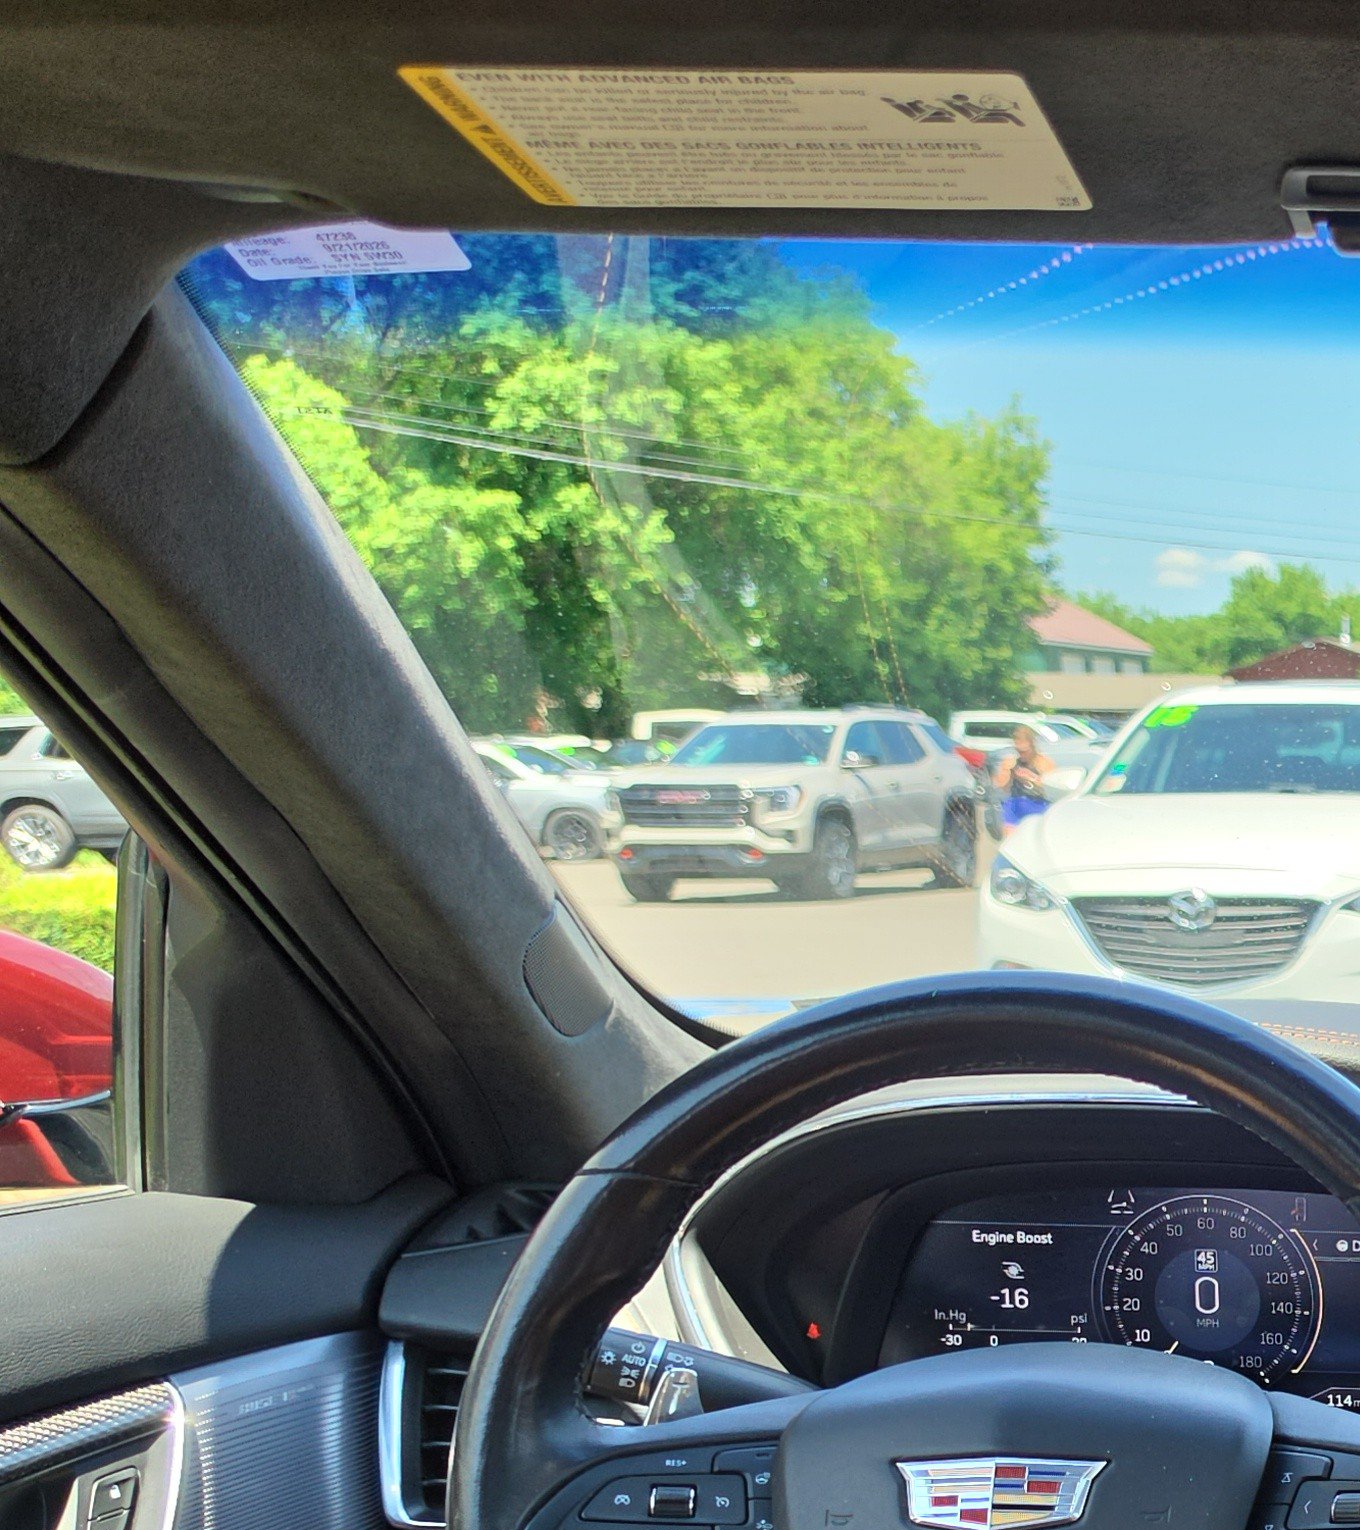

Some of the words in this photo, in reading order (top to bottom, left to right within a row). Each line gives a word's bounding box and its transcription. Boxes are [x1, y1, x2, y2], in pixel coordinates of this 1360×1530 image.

[456, 73, 511, 82] EVEN
[517, 73, 572, 83] WITH
[579, 74, 691, 84] ADVANCED
[699, 75, 731, 84] AIR
[737, 75, 795, 85] BAGS
[588, 141, 637, 150] AVEC
[640, 141, 678, 150] DES
[682, 142, 731, 151] SACS
[736, 142, 853, 151] GONFLABLES
[857, 142, 982, 151] INTELLIGENTS
[247, 258, 267, 268] Oil
[1197, 1217, 1215, 1230] 60
[972, 1229, 1014, 1247] Engine
[1016, 1231, 1054, 1245] Boost
[1166, 1224, 1184, 1238] 50
[1229, 1226, 1247, 1240] 80
[1139, 1241, 1158, 1255] 40
[1249, 1243, 1273, 1257] 100
[1196, 1250, 1215, 1264] 45
[1125, 1267, 1144, 1282] 30
[1266, 1271, 1289, 1285] 120
[990, 1287, 1029, 1309] -16
[1194, 1276, 1220, 1314] 0
[1122, 1297, 1141, 1312] 20
[1270, 1301, 1294, 1315] 140
[1070, 1312, 1088, 1326] psi
[1196, 1318, 1220, 1328] MPH
[940, 1334, 962, 1347] -30
[989, 1335, 999, 1348] 0
[1134, 1328, 1151, 1343] 10
[1260, 1332, 1283, 1346] 160
[621, 1353, 647, 1367] AUTO
[1239, 1355, 1263, 1369] 180
[665, 1459, 687, 1467] RES+
